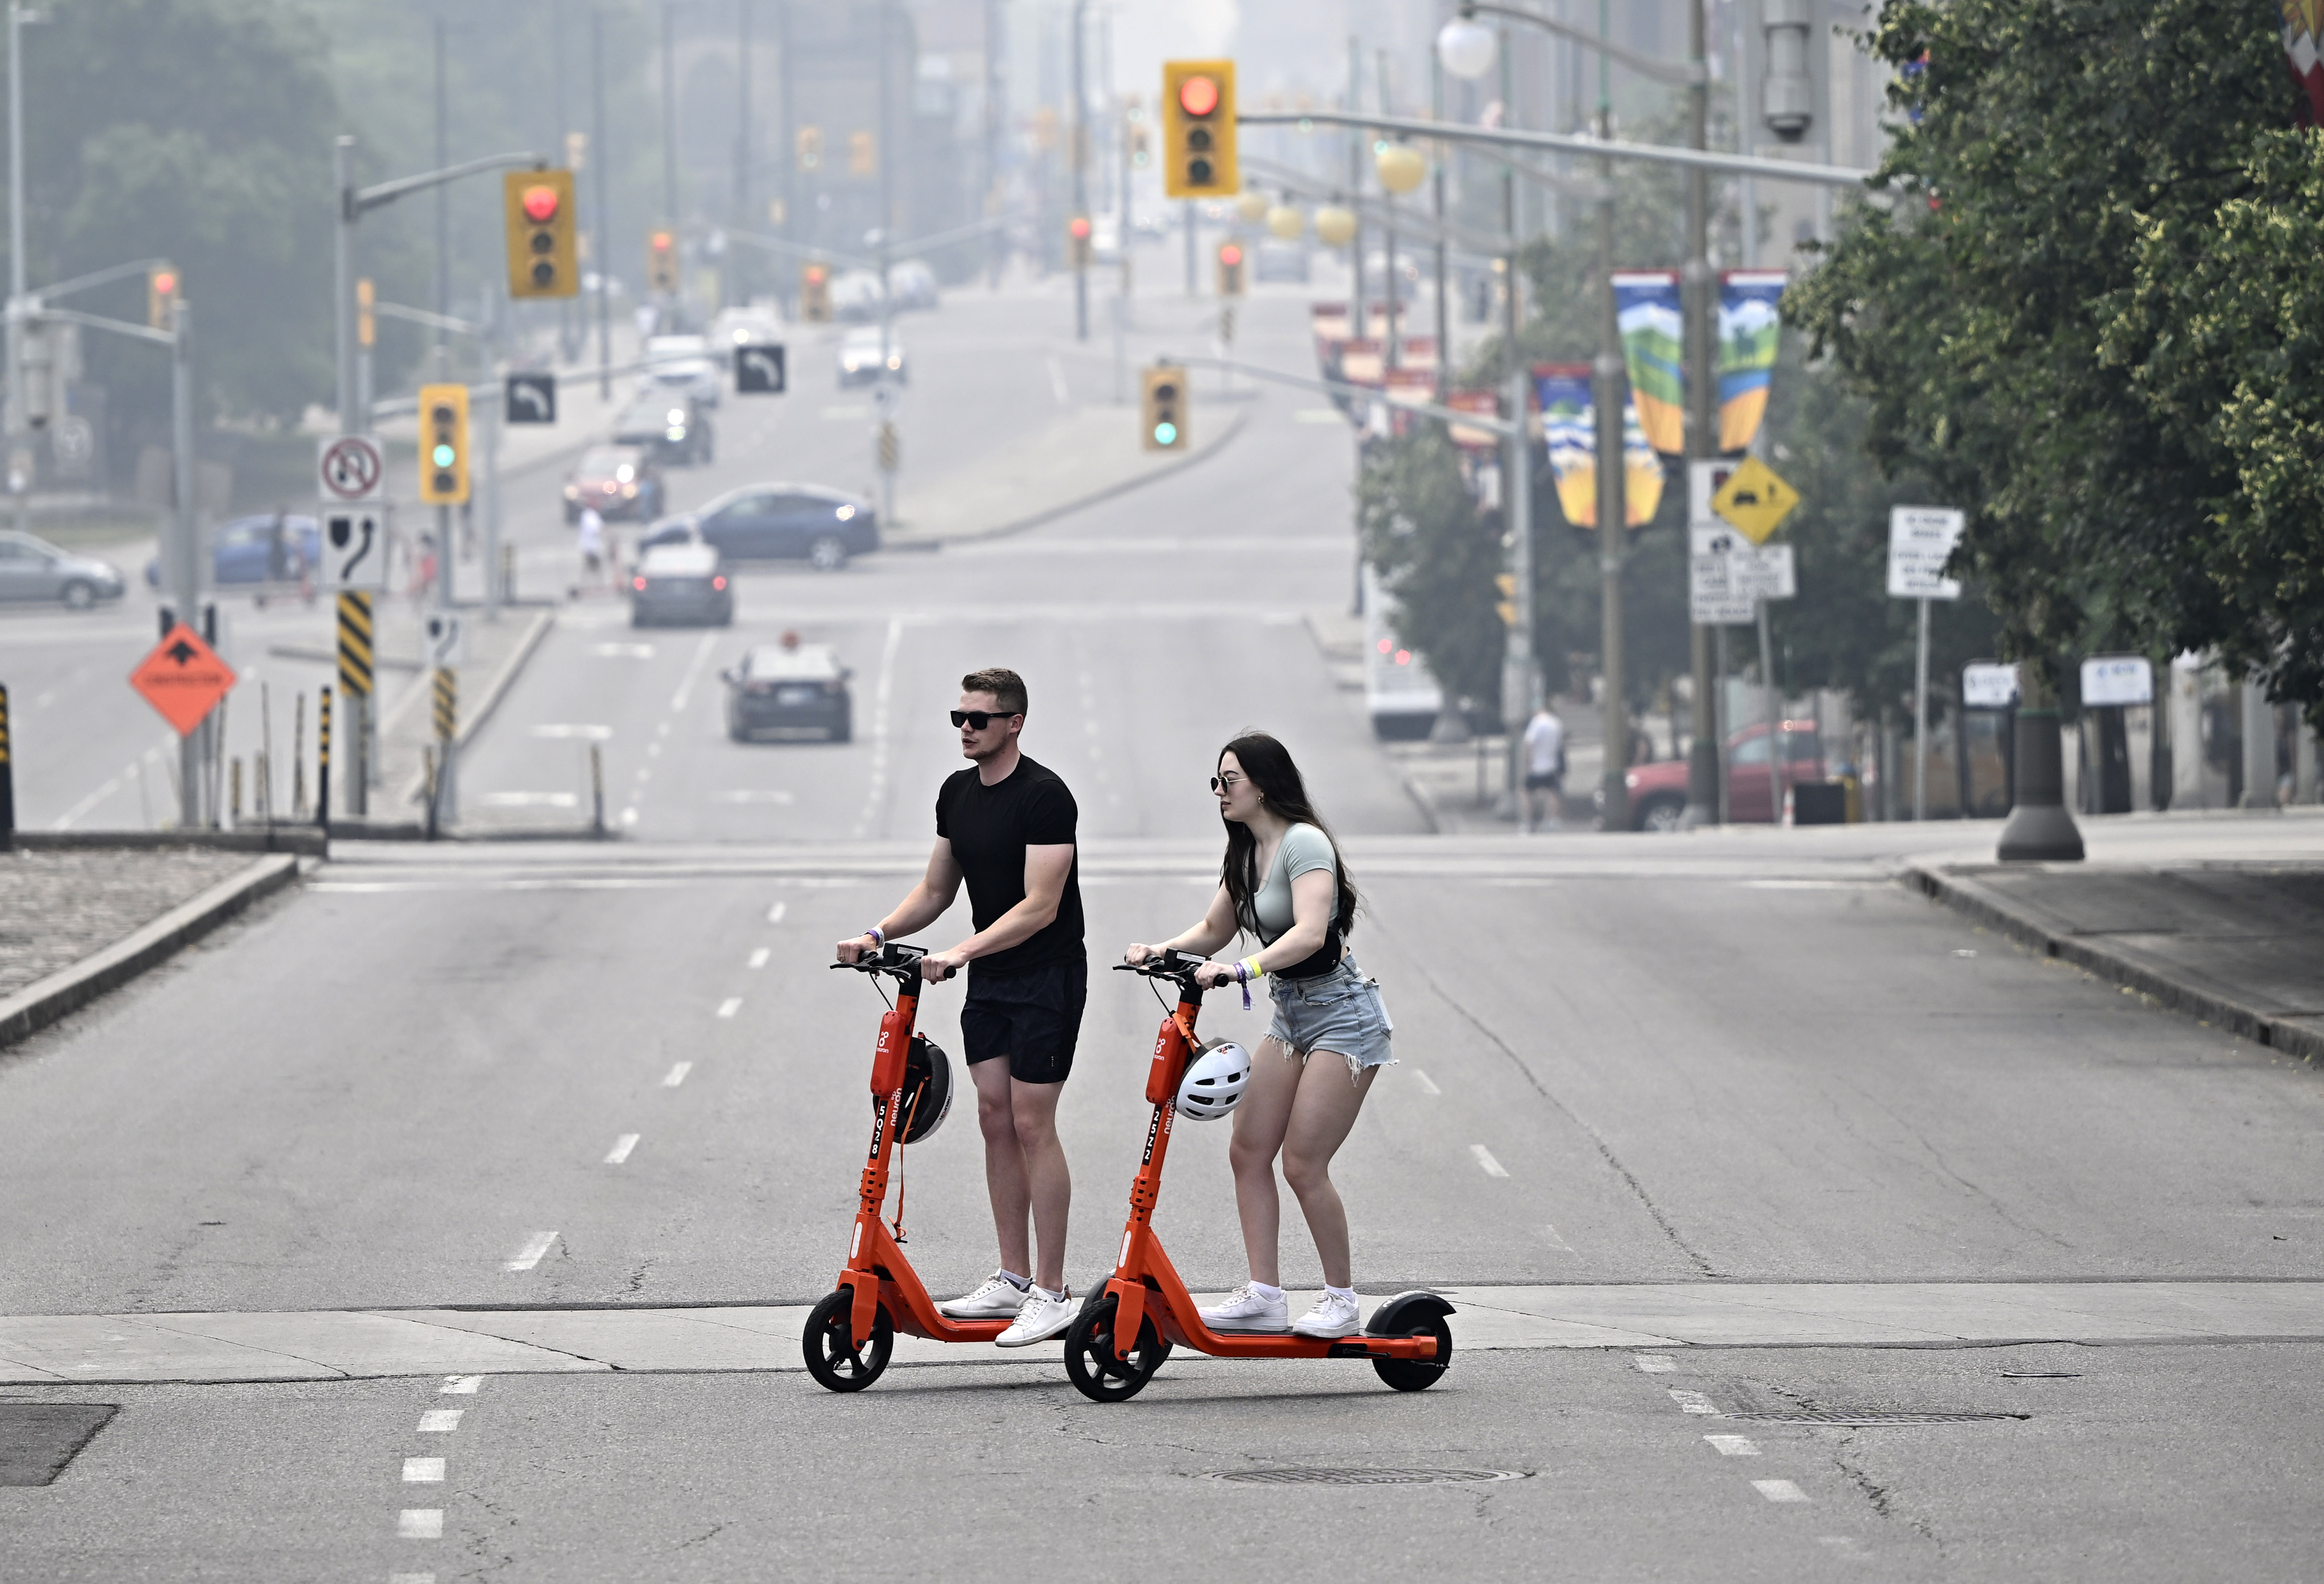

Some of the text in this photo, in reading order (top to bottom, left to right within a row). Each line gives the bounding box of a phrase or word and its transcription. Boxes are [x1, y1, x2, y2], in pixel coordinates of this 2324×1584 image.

[890, 1087, 902, 1127] neuron
[939, 1095, 951, 1120] neuron
[872, 1105, 885, 1154] 5Q28
